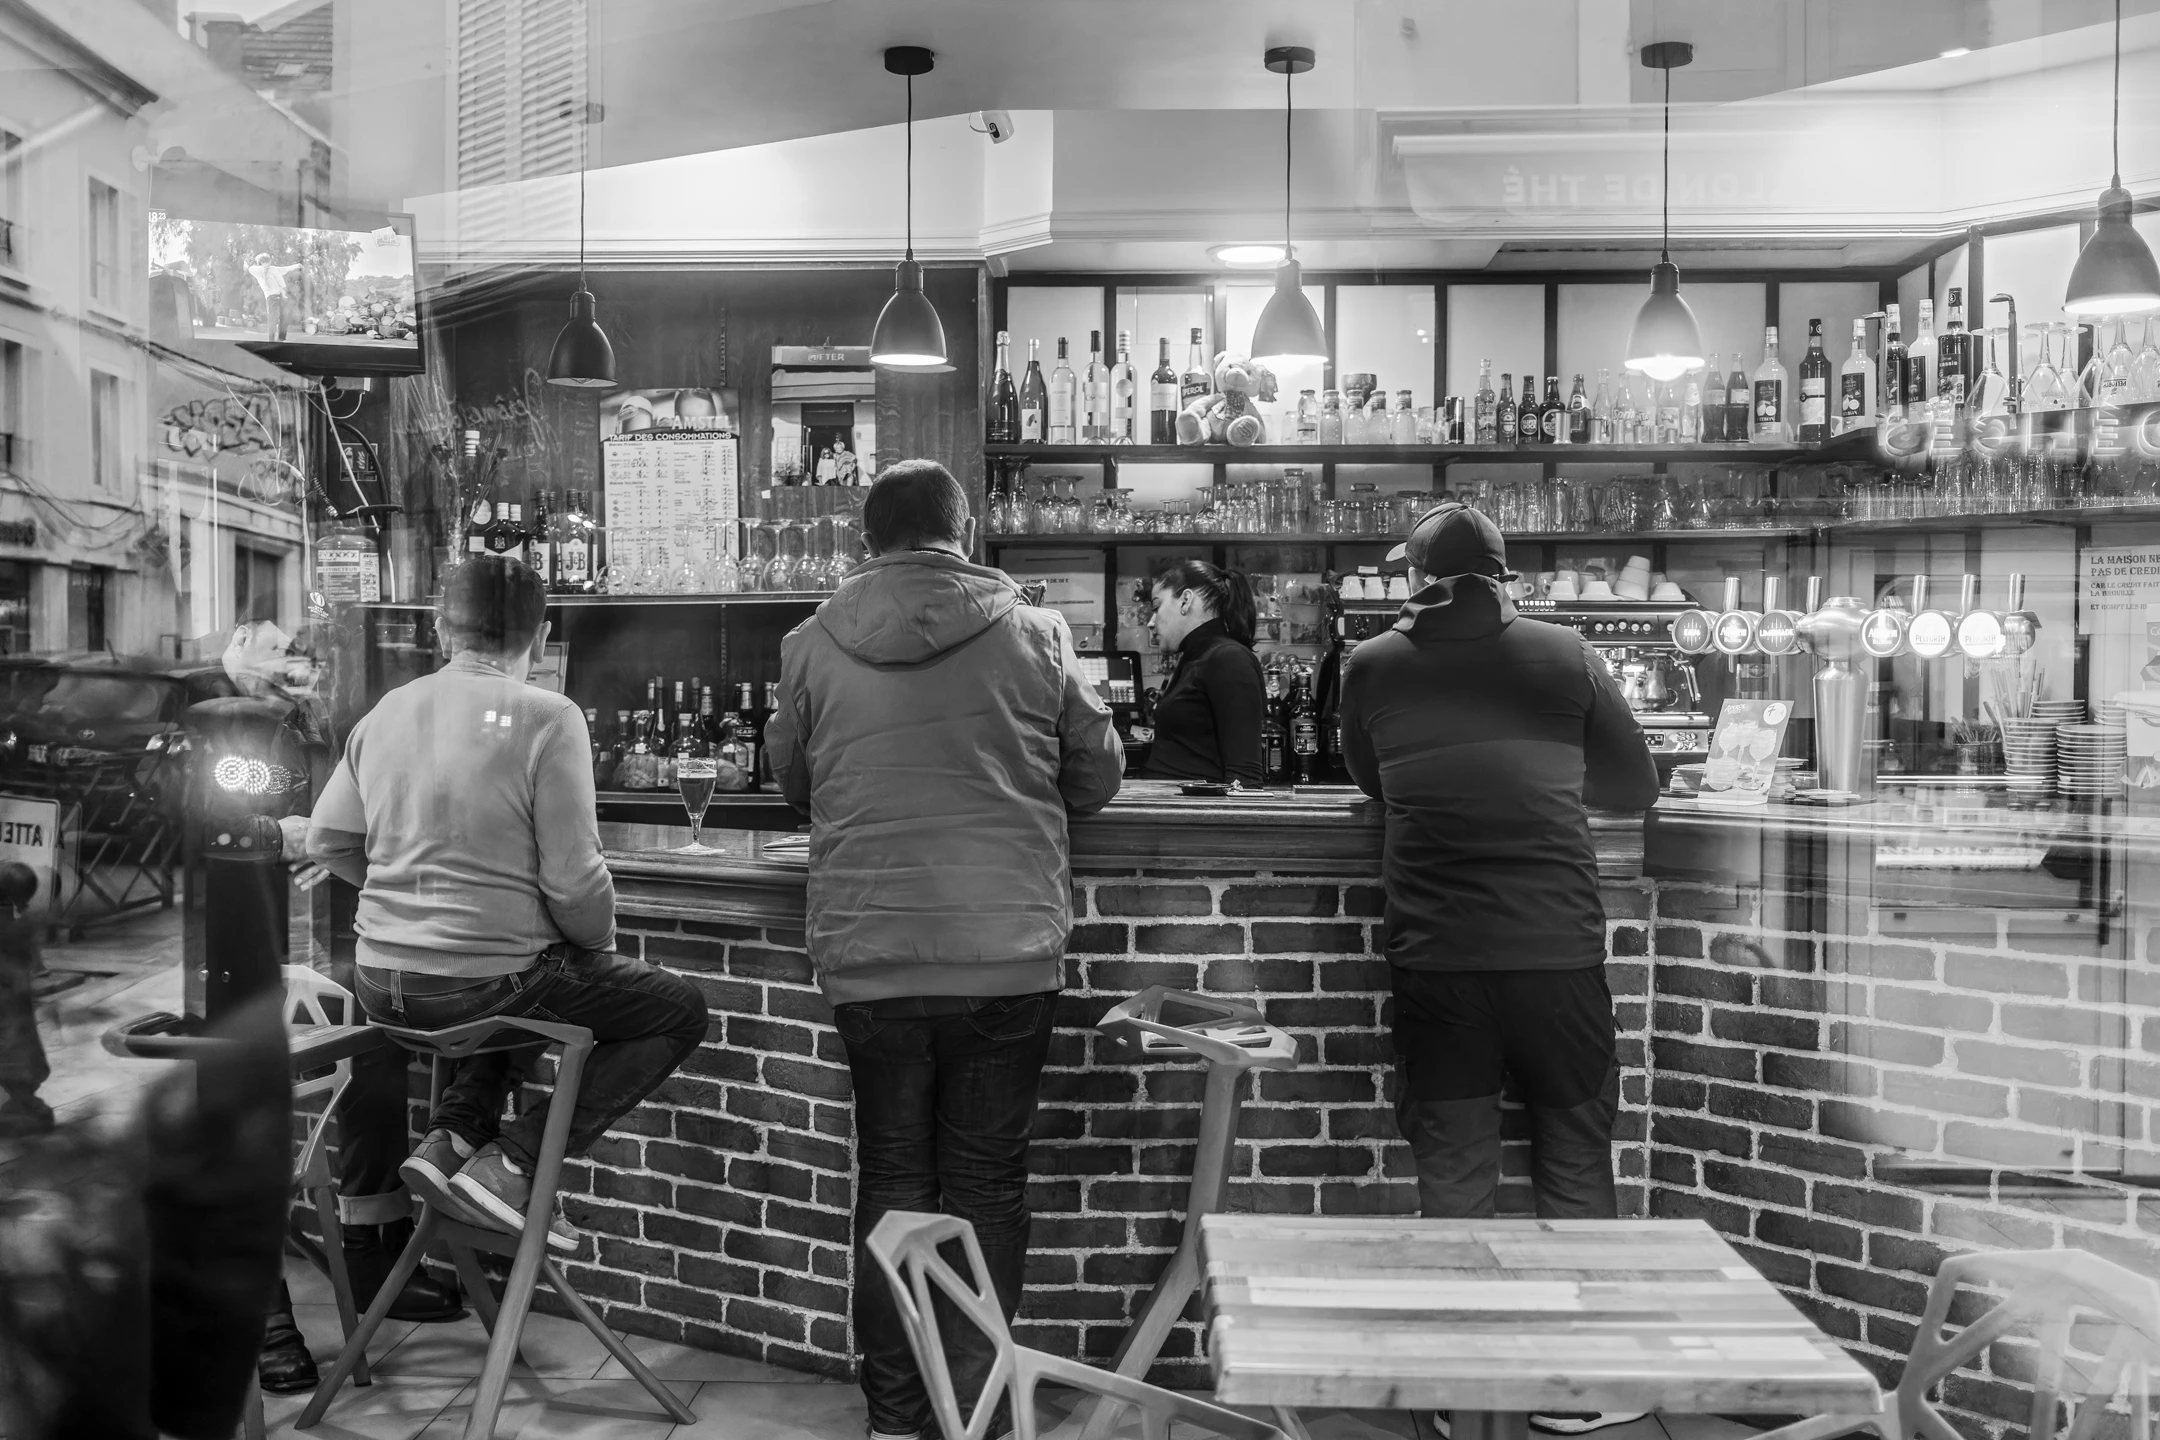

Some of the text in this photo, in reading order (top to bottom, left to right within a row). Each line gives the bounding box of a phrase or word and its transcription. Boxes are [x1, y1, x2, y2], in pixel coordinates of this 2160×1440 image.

[671, 415, 732, 430] AMSTEL
[609, 432, 732, 442] TARIF DES CONSOMMATIONS
[2091, 554, 2160, 564] LA MAISON NE
[2091, 568, 2111, 576] PAS
[2114, 567, 2127, 575] DE
[1759, 628, 1795, 637] LIMONADE
[1915, 634, 1946, 643] PELFORTH
